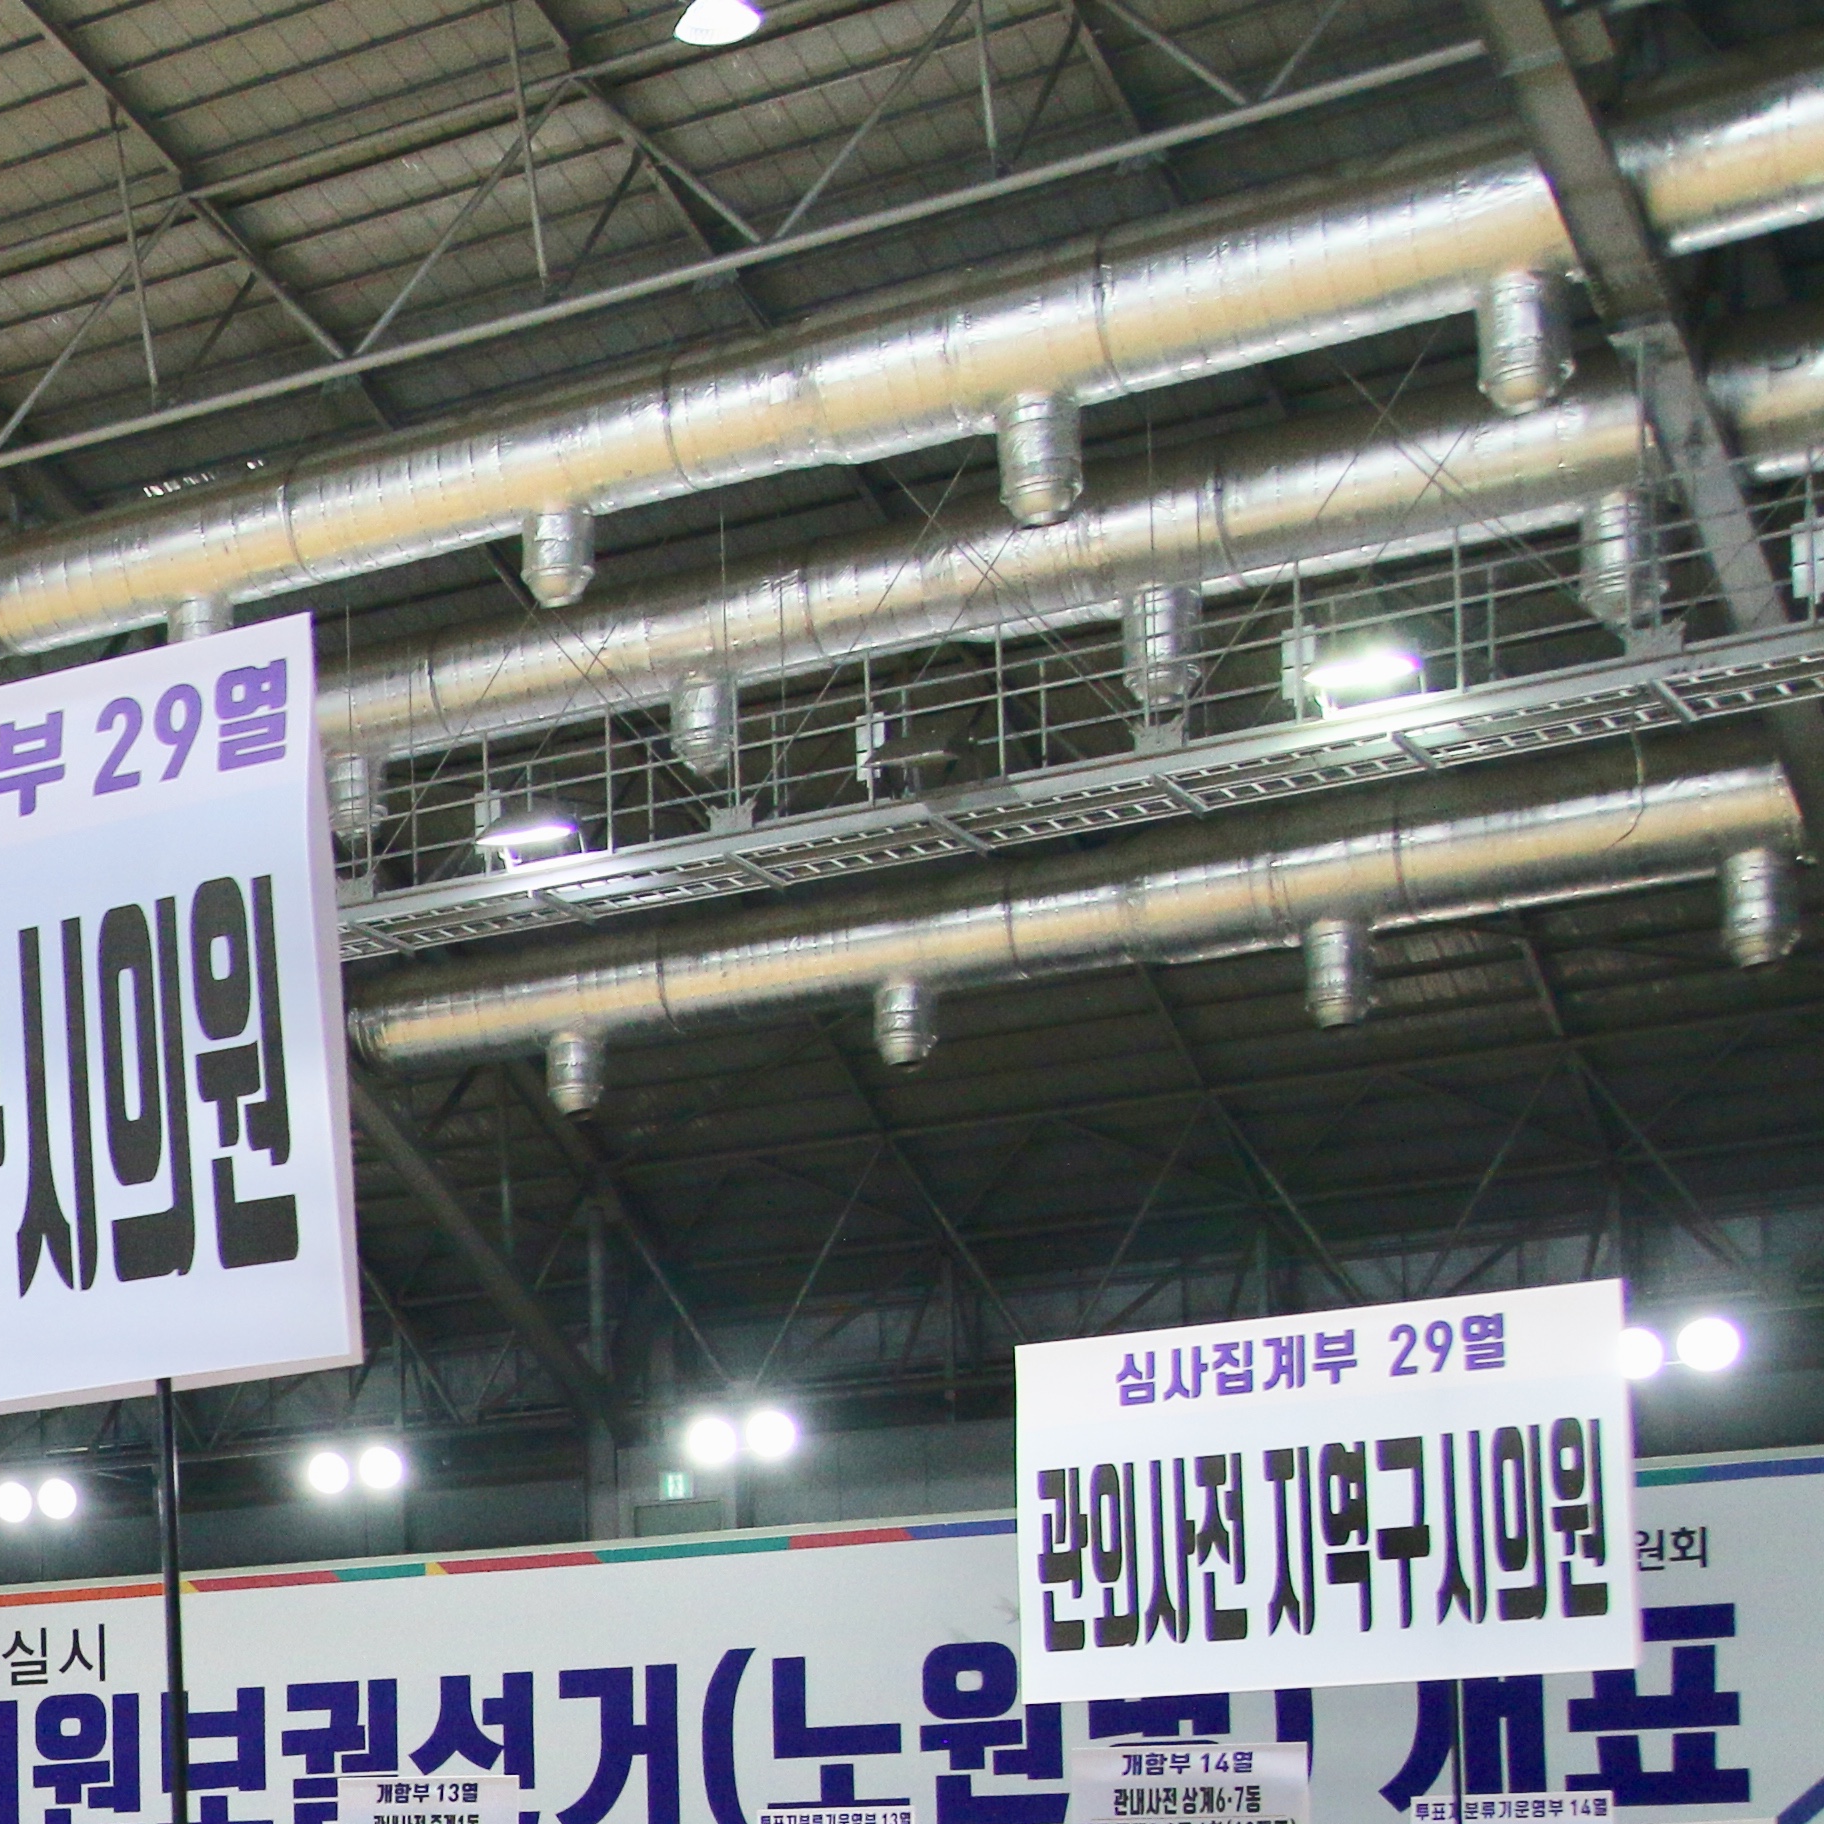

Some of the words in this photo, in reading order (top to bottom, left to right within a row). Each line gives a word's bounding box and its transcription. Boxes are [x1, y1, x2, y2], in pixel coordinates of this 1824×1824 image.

[92, 658, 288, 797] 29열
[1116, 1328, 1357, 1407] 심사집계부
[1389, 1312, 1507, 1378] 29열
[1035, 1451, 1247, 1653] 관외사전
[1261, 1415, 1609, 1636] 지역구시의원
[2, 1624, 107, 1686] 실시
[1122, 1753, 1191, 1776] 개함부
[1200, 1751, 1253, 1773] 14열
[376, 1784, 430, 1804] 개함부
[436, 1782, 479, 1802] 13열
[1114, 1788, 1177, 1816] 관내사전
[1571, 1797, 1608, 1817] 14열
